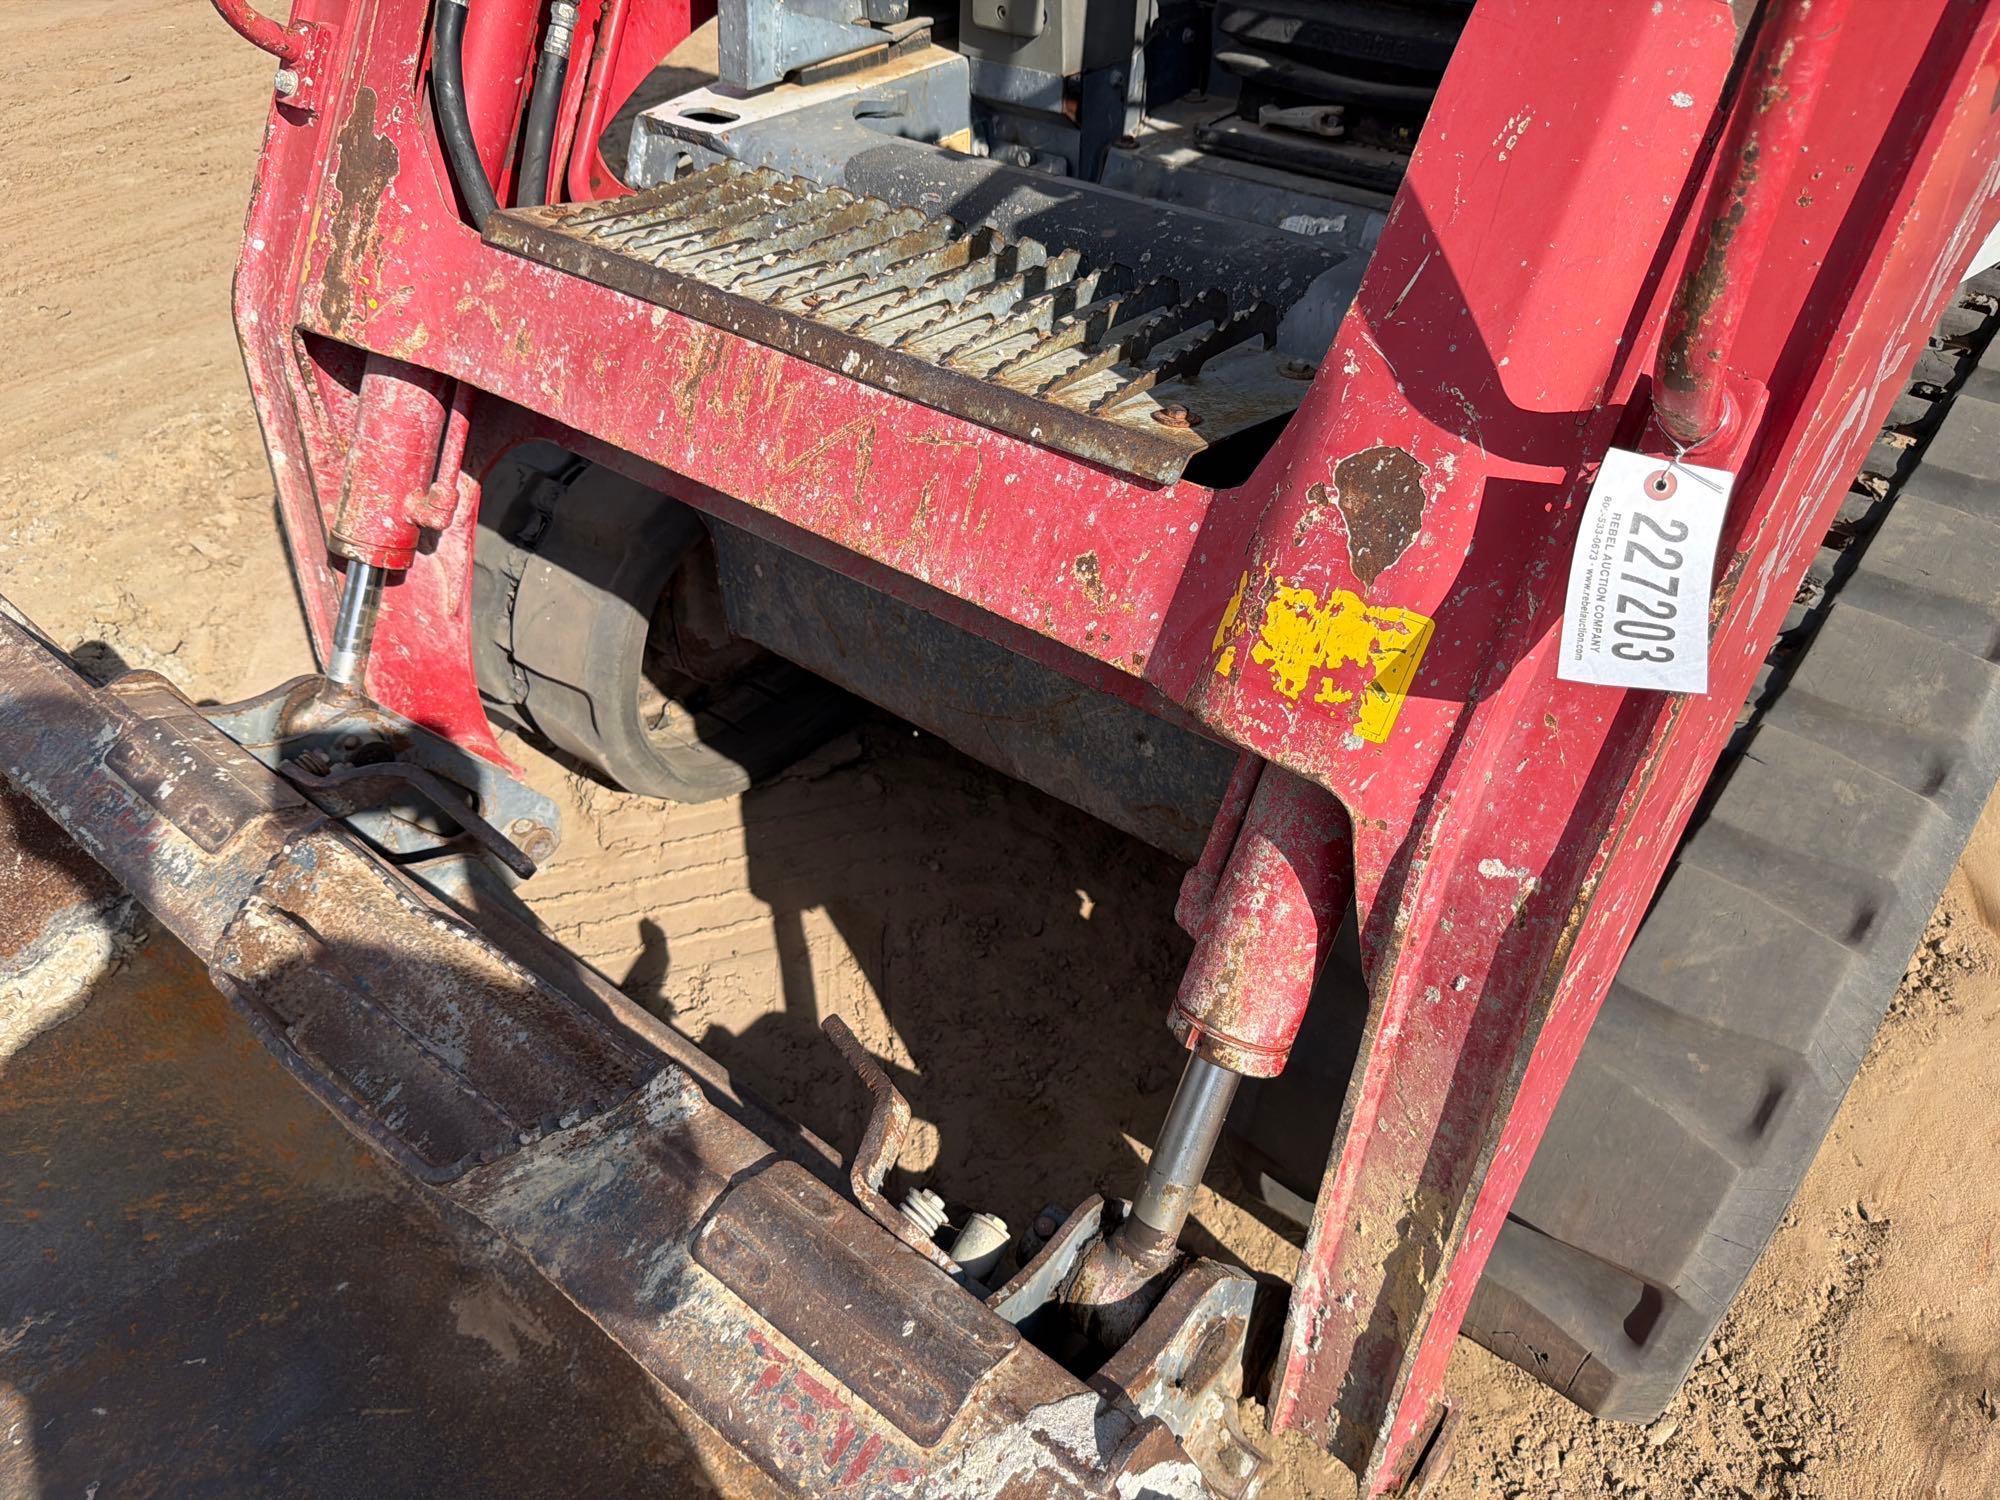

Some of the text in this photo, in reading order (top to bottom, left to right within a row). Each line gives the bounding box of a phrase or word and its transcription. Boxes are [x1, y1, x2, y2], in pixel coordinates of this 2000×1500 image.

[1575, 568, 1594, 661] www.rebelauction.com
[1590, 512, 1622, 653] REBEL AUCTION COMPANY
[1611, 511, 1689, 663] 227203
